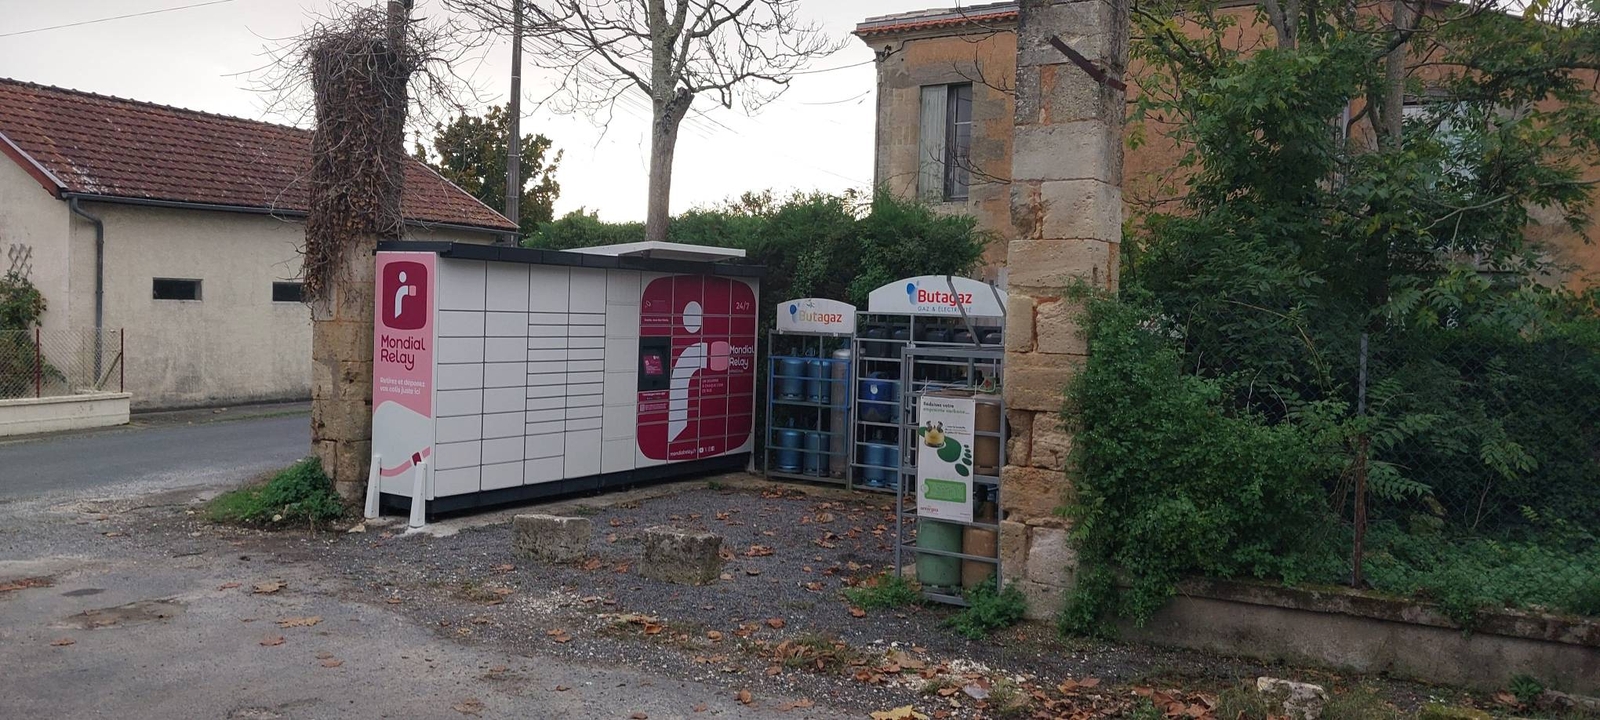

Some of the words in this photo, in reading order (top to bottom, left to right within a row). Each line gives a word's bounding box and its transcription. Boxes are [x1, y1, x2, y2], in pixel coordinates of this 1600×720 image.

[917, 289, 973, 307] Butagaz
[735, 302, 750, 311] 24/7
[938, 305, 972, 313] ÉLECTRTÉ
[800, 310, 842, 325] Butagaz
[381, 334, 426, 351] Mondial
[729, 345, 755, 355] Mondial
[381, 348, 415, 371] Relay
[729, 356, 749, 370] Relay
